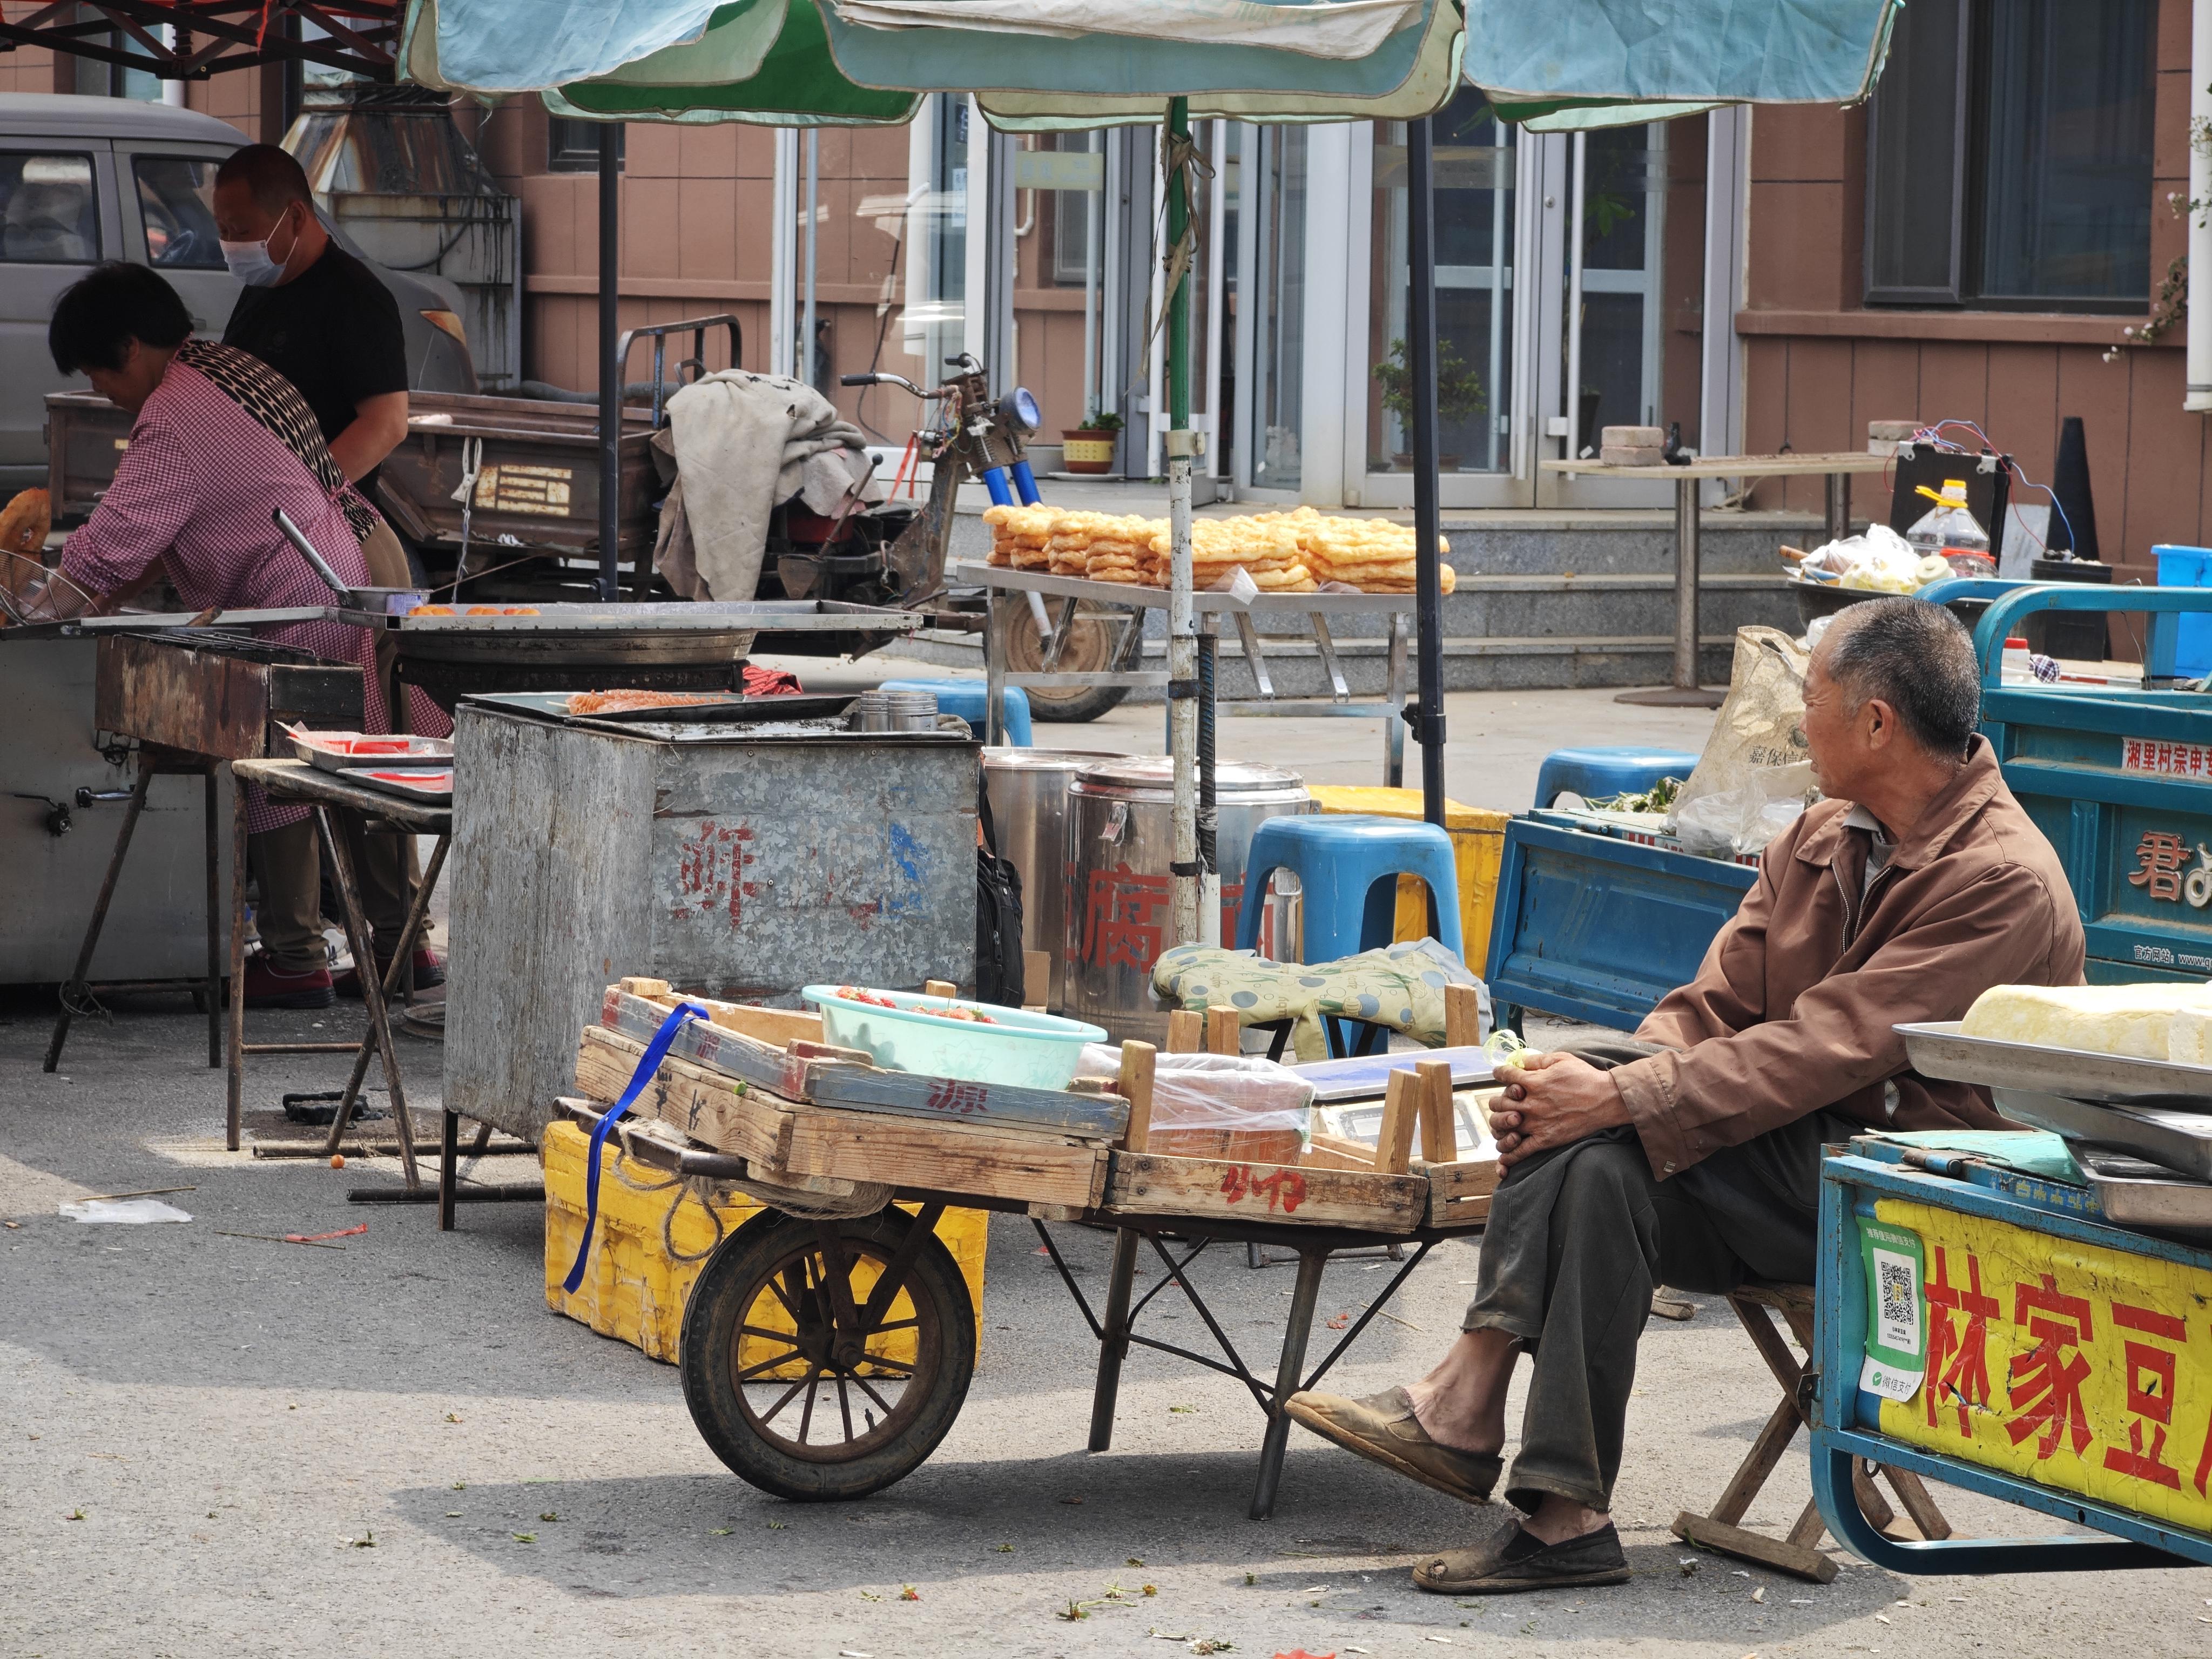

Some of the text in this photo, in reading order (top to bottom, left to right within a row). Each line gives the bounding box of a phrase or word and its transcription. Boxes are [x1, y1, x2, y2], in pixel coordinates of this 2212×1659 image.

[1866, 1227, 1916, 1249] 推荐使用微信支付
[1924, 1245, 2212, 1500] 林家豆
[1882, 1375, 1911, 1394] 微信支付
